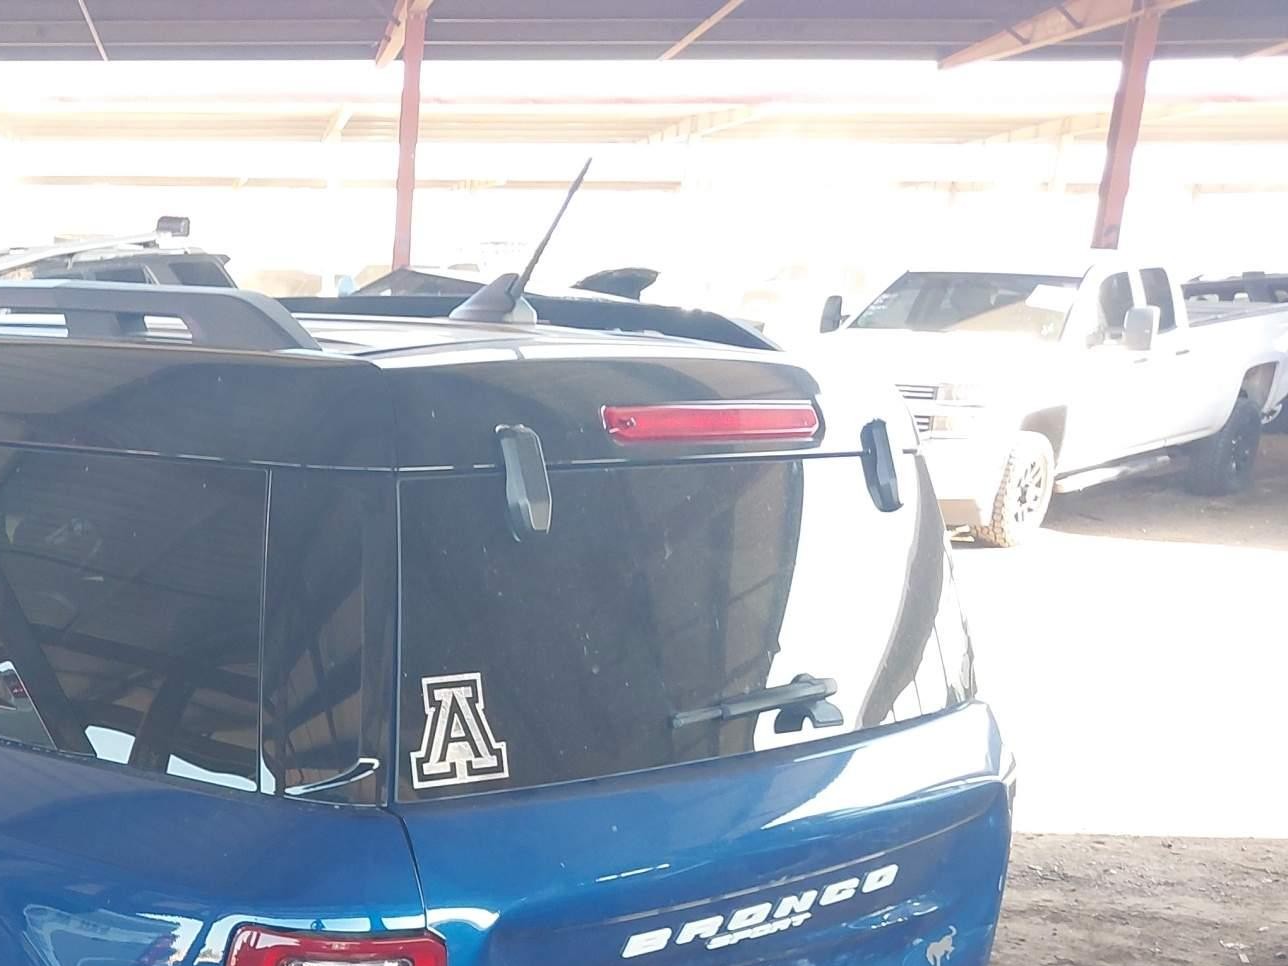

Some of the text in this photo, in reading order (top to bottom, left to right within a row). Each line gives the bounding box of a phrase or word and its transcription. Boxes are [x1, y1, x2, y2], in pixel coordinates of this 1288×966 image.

[410, 671, 509, 789] A
[620, 862, 900, 959] BRONCO
[704, 912, 812, 950] SPORT
